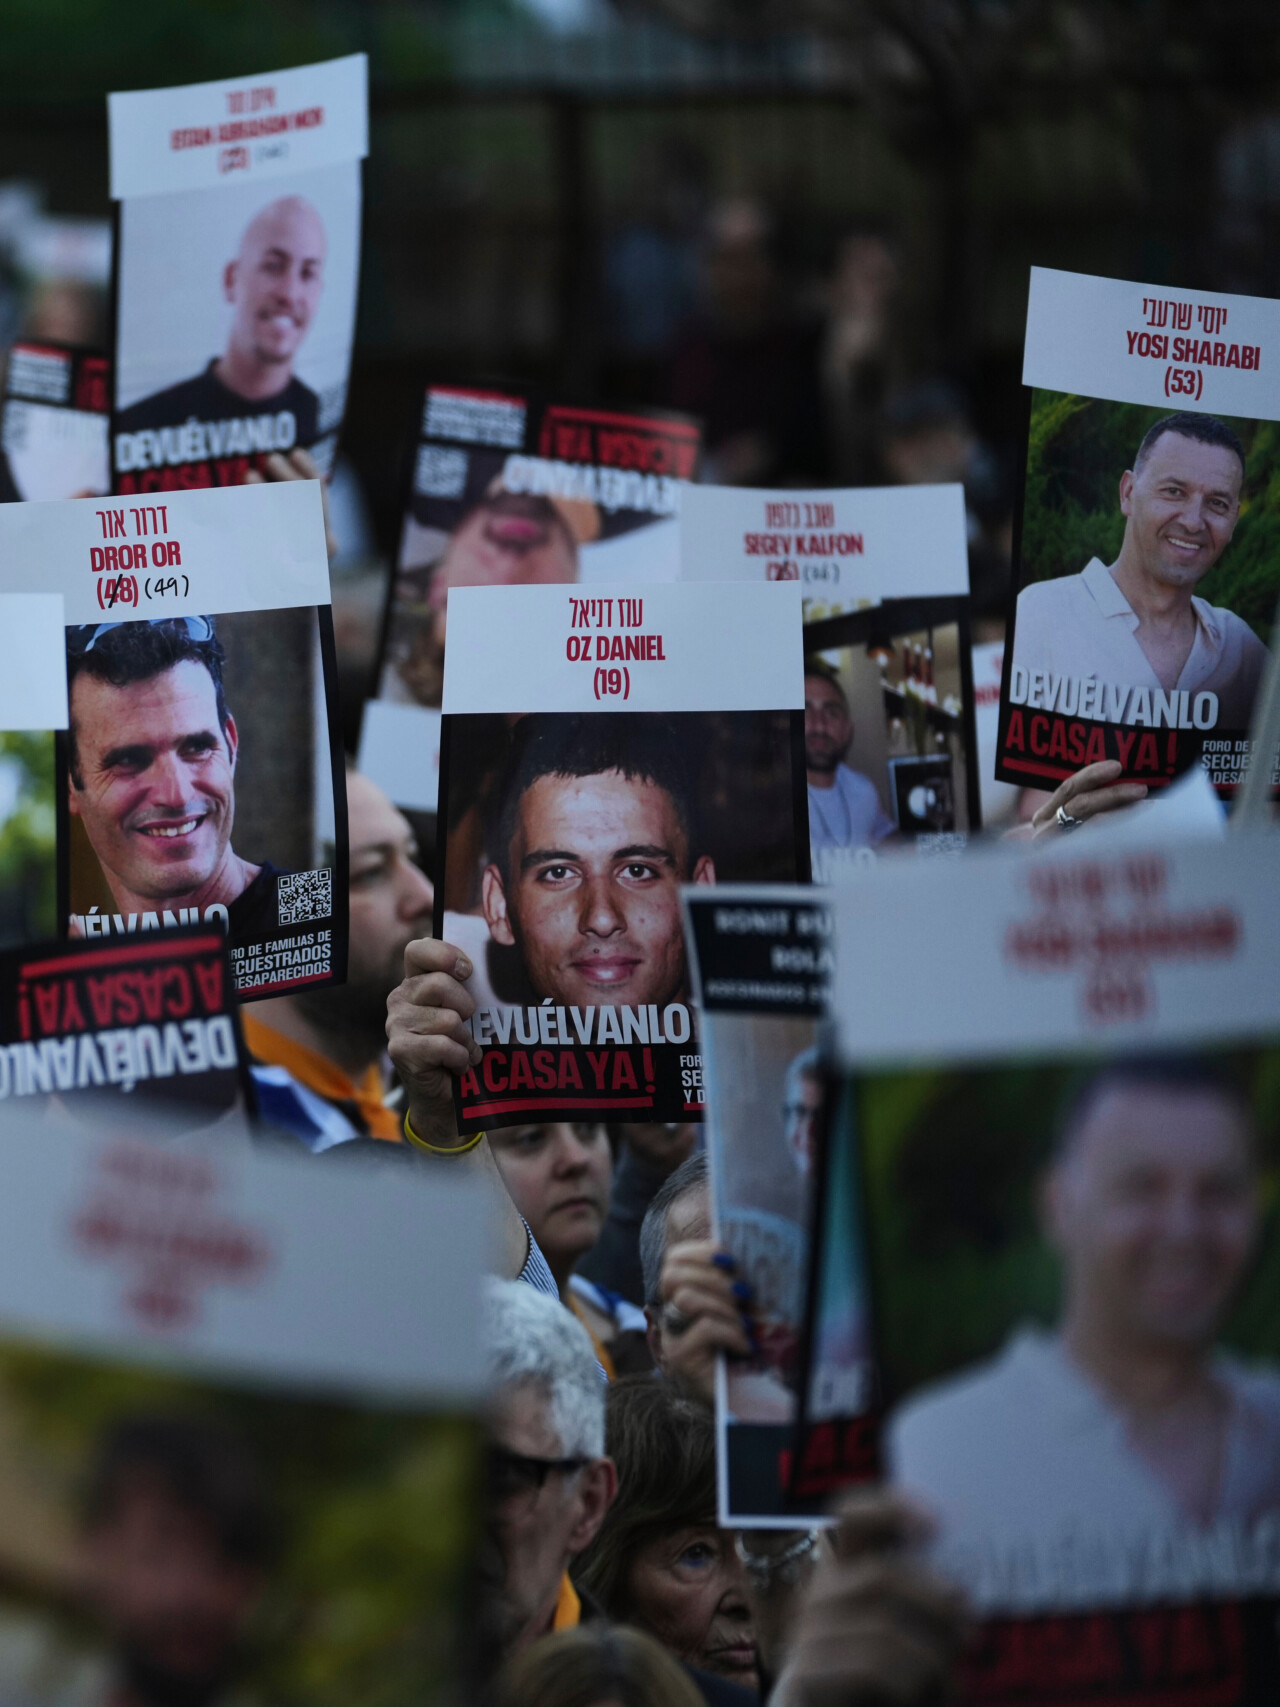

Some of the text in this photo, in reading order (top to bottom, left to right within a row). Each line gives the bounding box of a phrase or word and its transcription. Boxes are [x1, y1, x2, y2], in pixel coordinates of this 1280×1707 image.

[1143, 298, 1228, 334] יוסי שרעבי
[1126, 330, 1261, 371] YOSI SHARABI
[1165, 366, 1203, 401] (53)
[96, 506, 168, 538] דרור אור
[90, 541, 182, 572] DROR OR
[96, 574, 139, 609] (48)
[145, 575, 189, 600] (49)
[568, 597, 643, 628] עוז דניאל
[566, 635, 666, 662] OZ DANIEL
[593, 667, 630, 700] (19)
[1009, 662, 1219, 731] DEVUÉLVANLO
[1004, 710, 1025, 751] A
[1030, 714, 1107, 766] CASA
[248, 944, 262, 957] DE
[265, 933, 314, 954] FAMILIAS
[318, 930, 332, 943] DE
[466, 998, 691, 1046] EVUÉLVANLO
[482, 1050, 584, 1093] CASA
